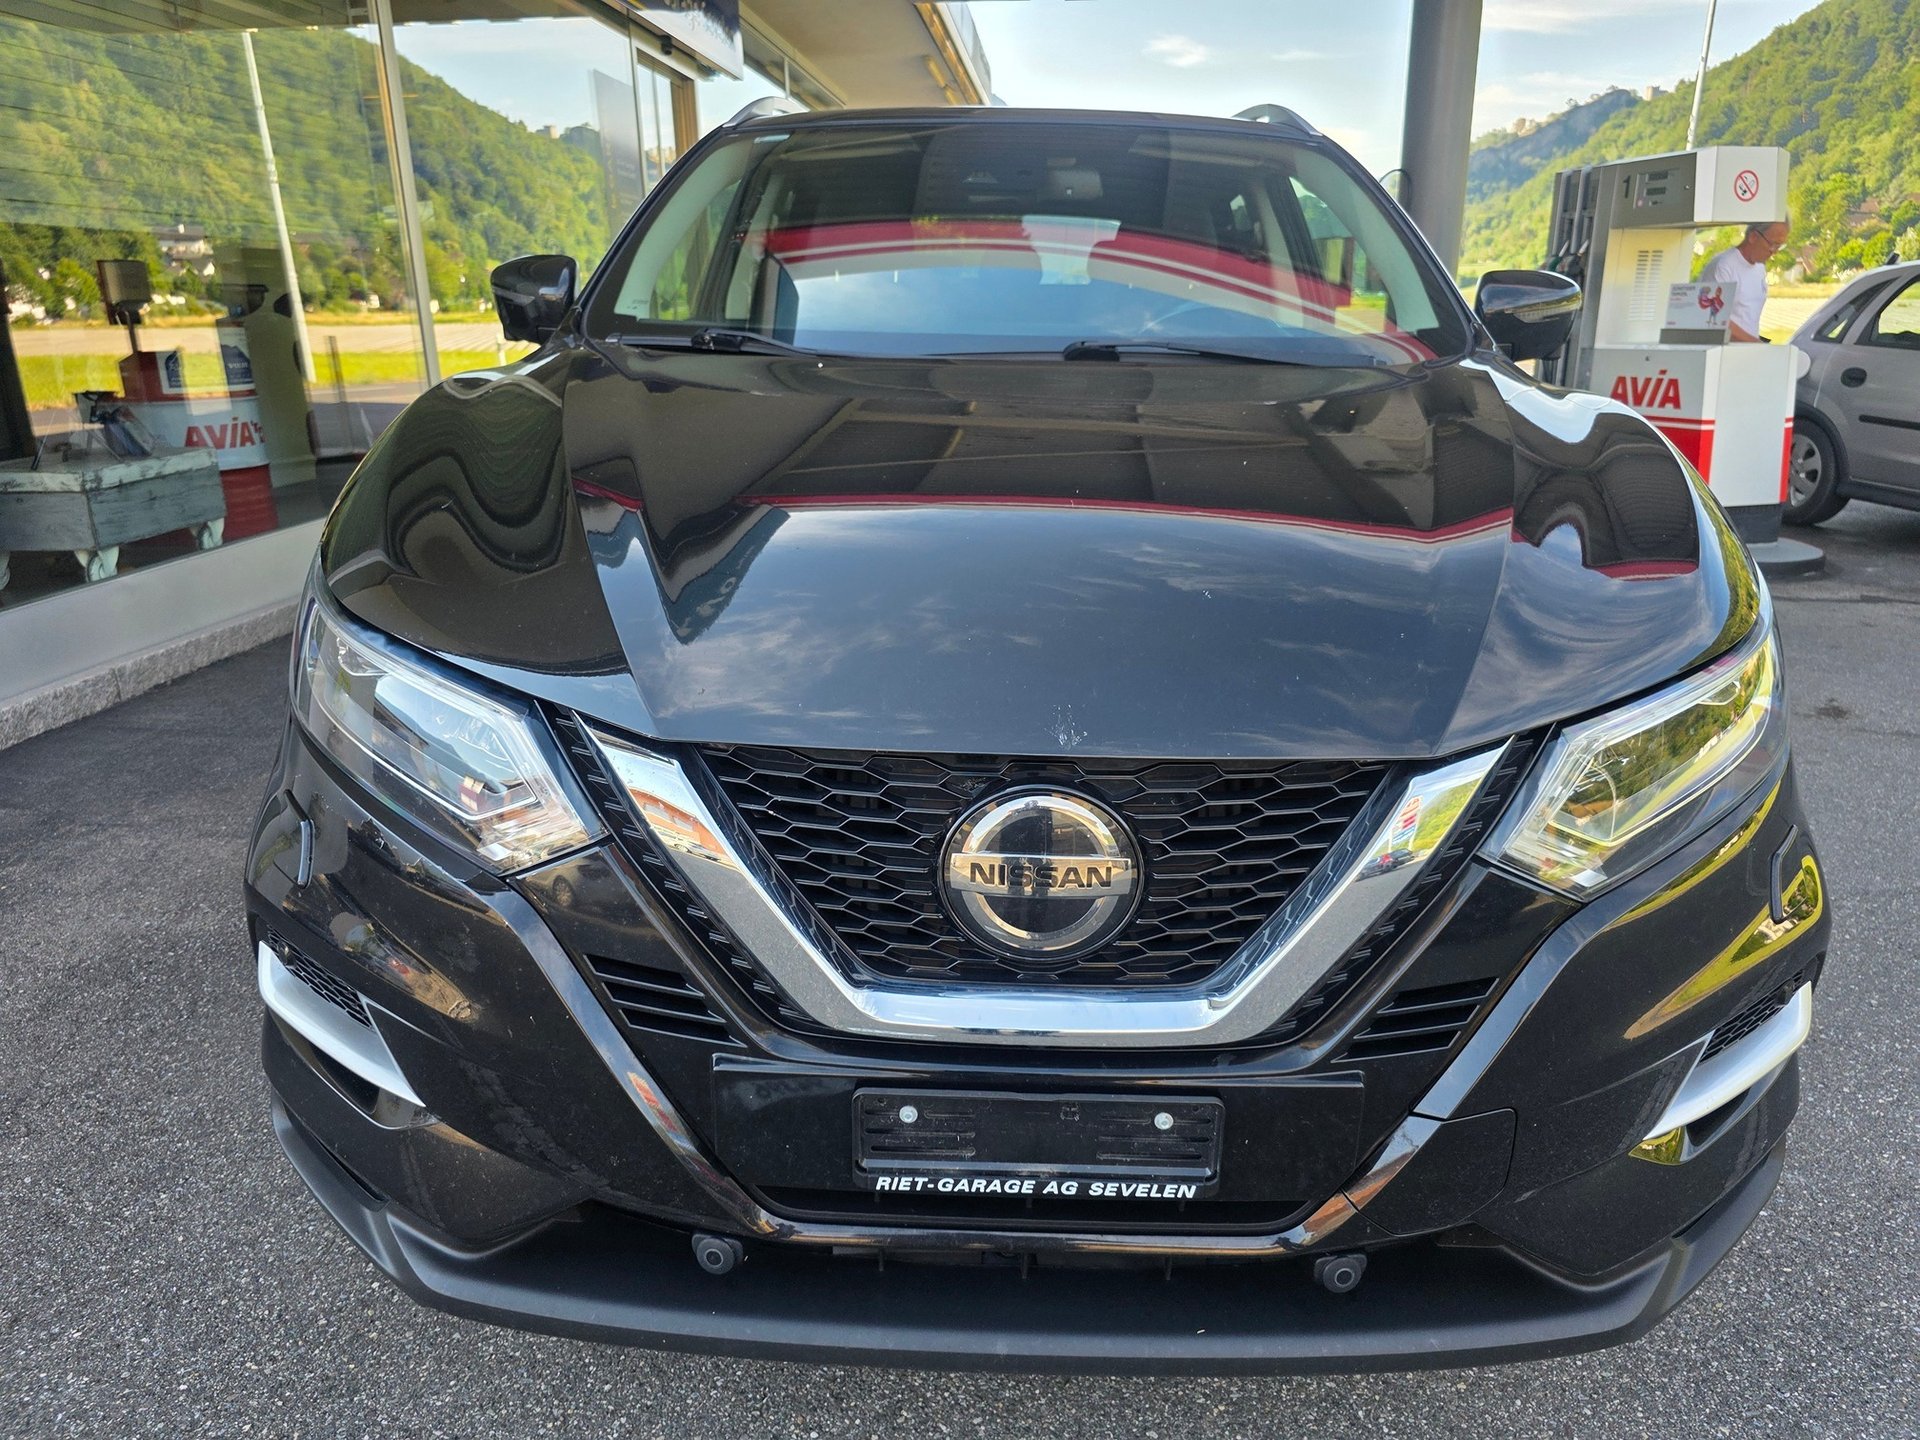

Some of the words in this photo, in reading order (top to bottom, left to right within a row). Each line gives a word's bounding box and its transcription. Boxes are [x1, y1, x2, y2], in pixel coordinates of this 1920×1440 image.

[969, 862, 1113, 889] NISSAN
[875, 1176, 1034, 1194] RIET-GARAGE
[1042, 1181, 1079, 1196] AG
[1088, 1182, 1197, 1199] SEVELEN
